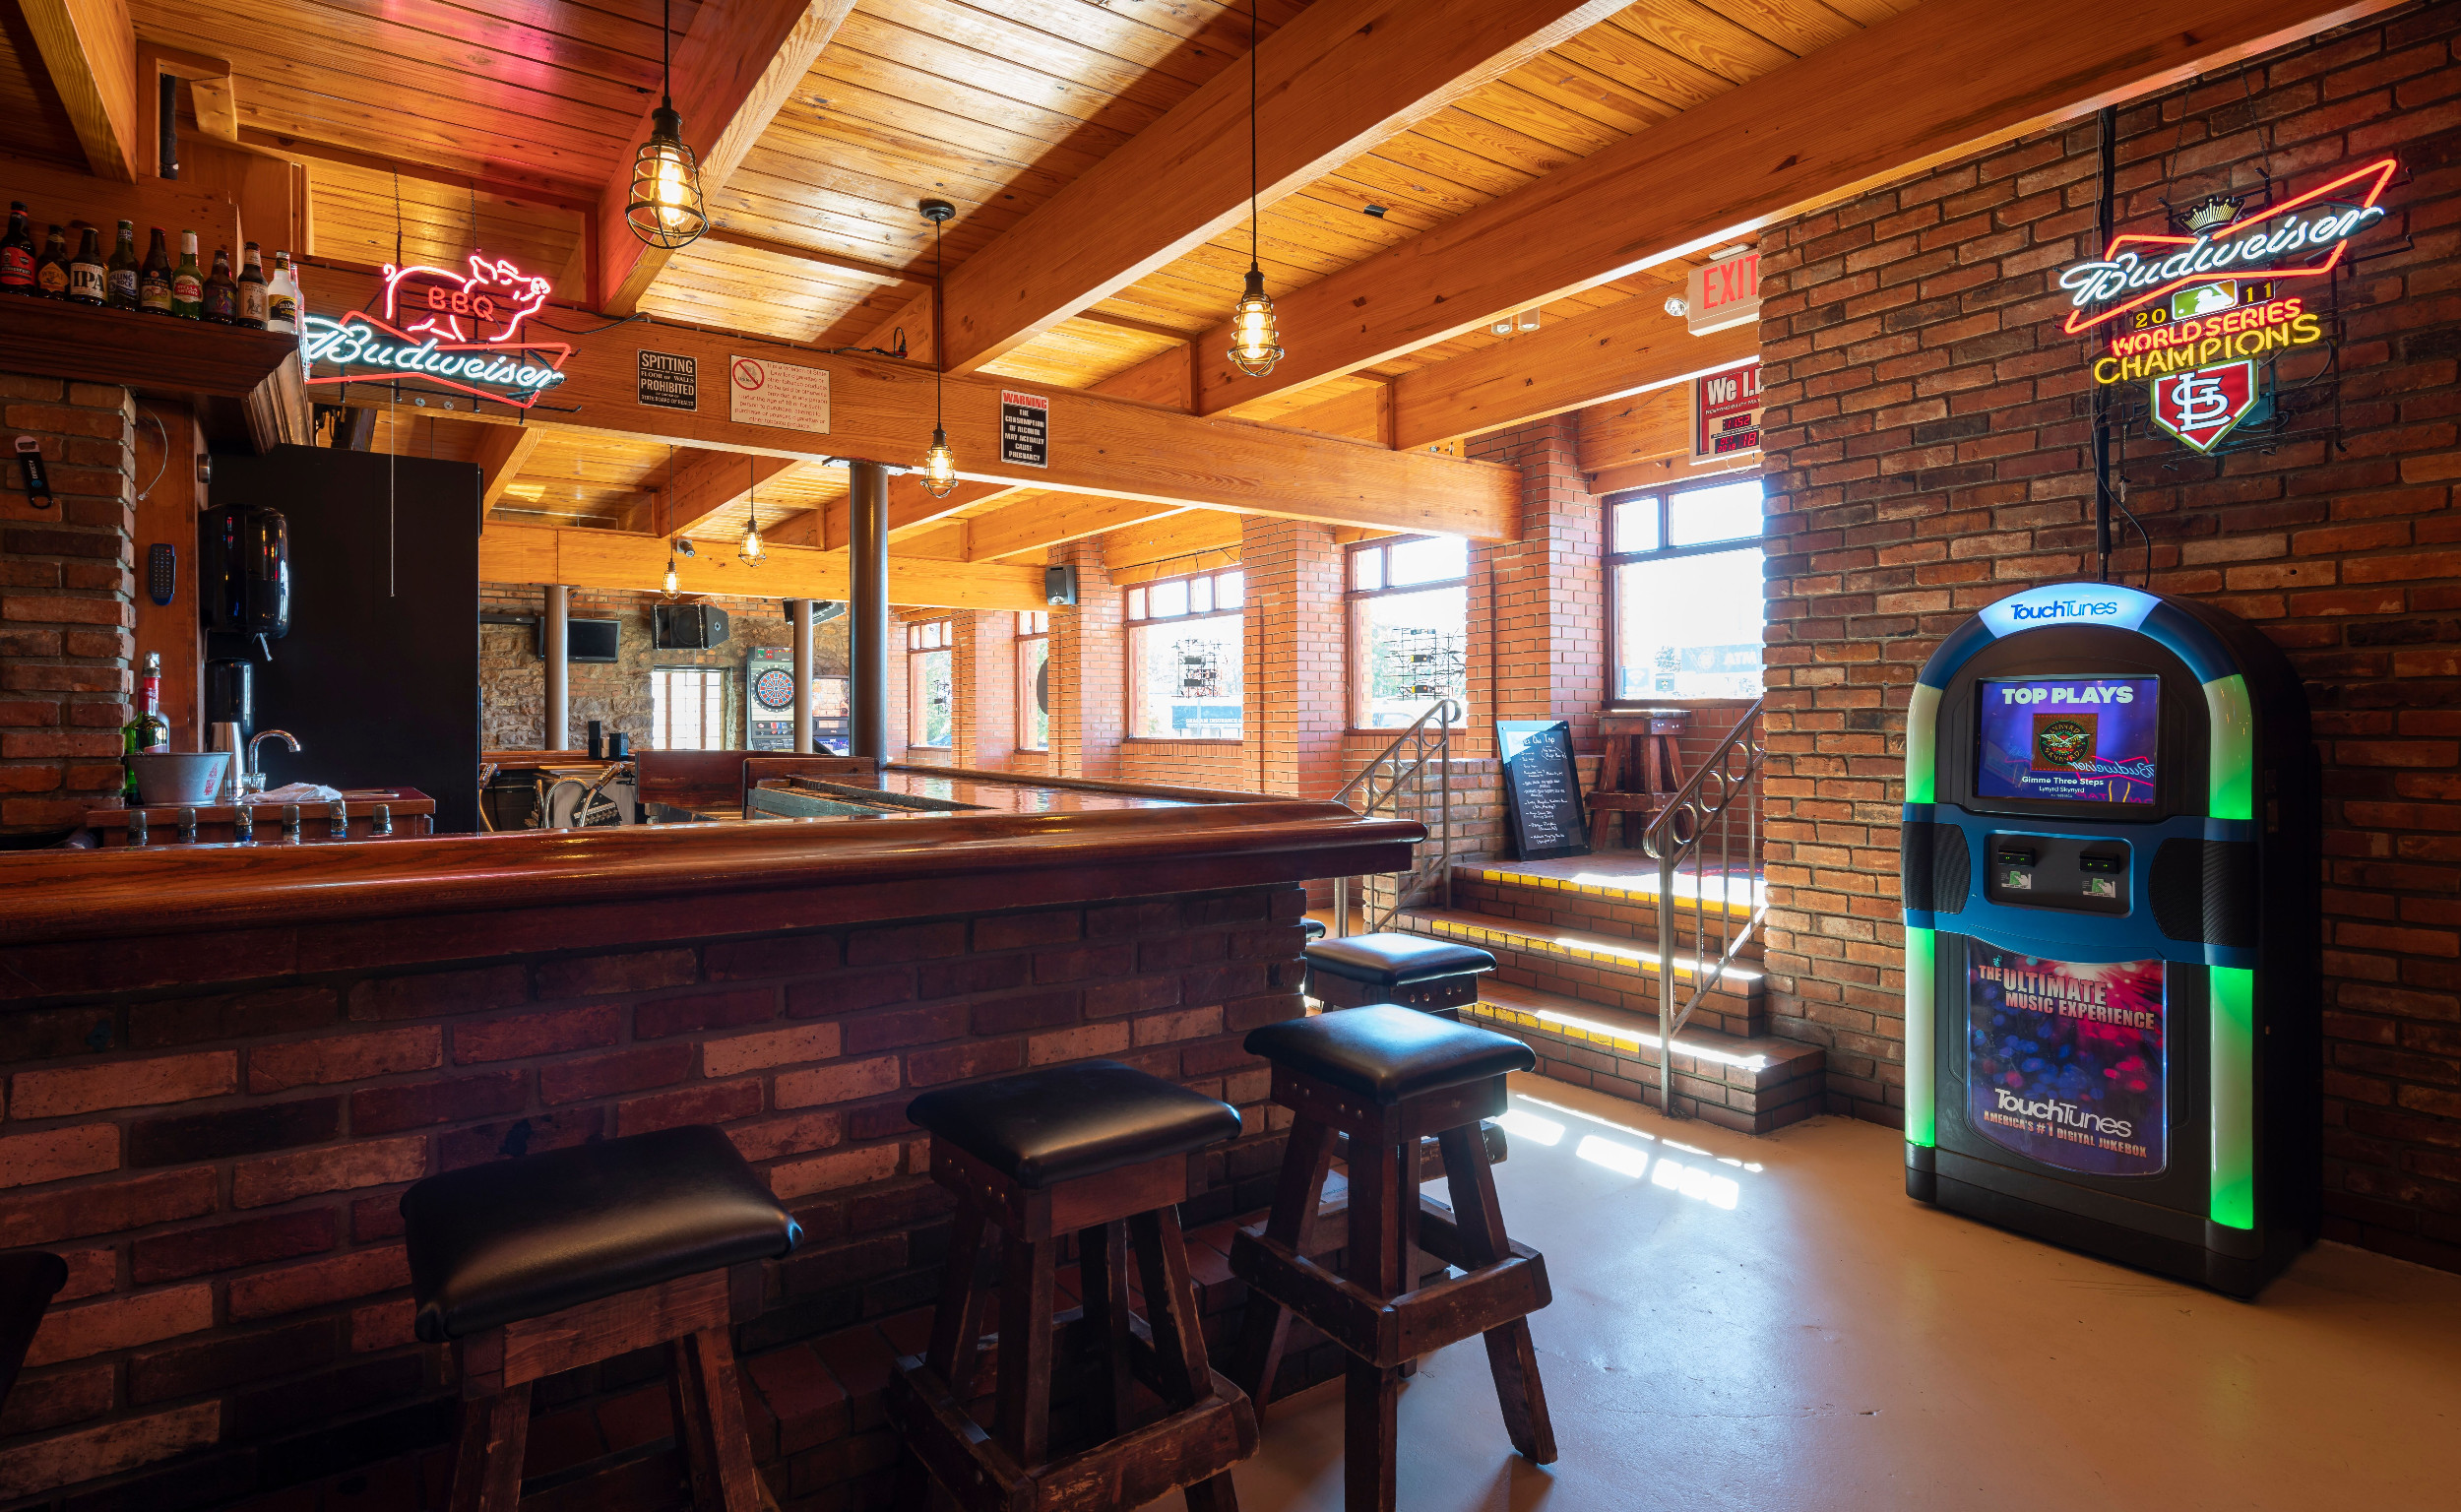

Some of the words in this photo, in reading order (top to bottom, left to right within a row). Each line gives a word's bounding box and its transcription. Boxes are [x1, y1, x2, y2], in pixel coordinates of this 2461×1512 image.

[2059, 207, 2384, 306] Budweiser
[74, 271, 104, 292] IPA
[1703, 254, 1760, 310] EXIT
[428, 285, 494, 321] BBQ
[2135, 308, 2168, 329] 20
[2245, 282, 2273, 303] 11
[2111, 321, 2202, 357] WORLD
[2205, 298, 2303, 337] SERIES
[304, 317, 565, 389] Budweiser
[2094, 313, 2321, 384] CHAMPIONS
[642, 353, 693, 373] SPITTING
[641, 370, 663, 379] FLOOR
[673, 375, 694, 384] WALLS
[641, 378, 694, 396] PROHIBITED
[1003, 393, 1047, 409] WARNING
[1707, 376, 1736, 406] We
[1005, 415, 1044, 428] CONSUMPTION
[1018, 426, 1041, 435] ALCOHOL
[1019, 435, 1044, 445] ACTUALLY
[1717, 443, 1735, 453] 2018
[1743, 432, 1756, 447] 18
[1009, 451, 1041, 462] PREGNANCY
[2011, 600, 2117, 619] TouchTunes
[1723, 651, 1757, 665] ATM
[2002, 687, 2048, 705] TOP
[2051, 685, 2134, 704] PLAYS
[2050, 724, 2080, 734] LYNYRD
[2079, 778, 2104, 787] Steps
[1979, 965, 2002, 982] THE
[2003, 968, 2107, 1006] ULTIMATE
[2005, 990, 2054, 1014] MUSIC
[2058, 1001, 2155, 1031] EXPERIENCE
[1995, 1088, 2132, 1138] TouchTunes
[1984, 1110, 2034, 1132] AMERICA'S
[2037, 1120, 2054, 1137] #1
[2056, 1127, 2095, 1147] DIGITAL
[2099, 1137, 2147, 1159] JUKEBOX
